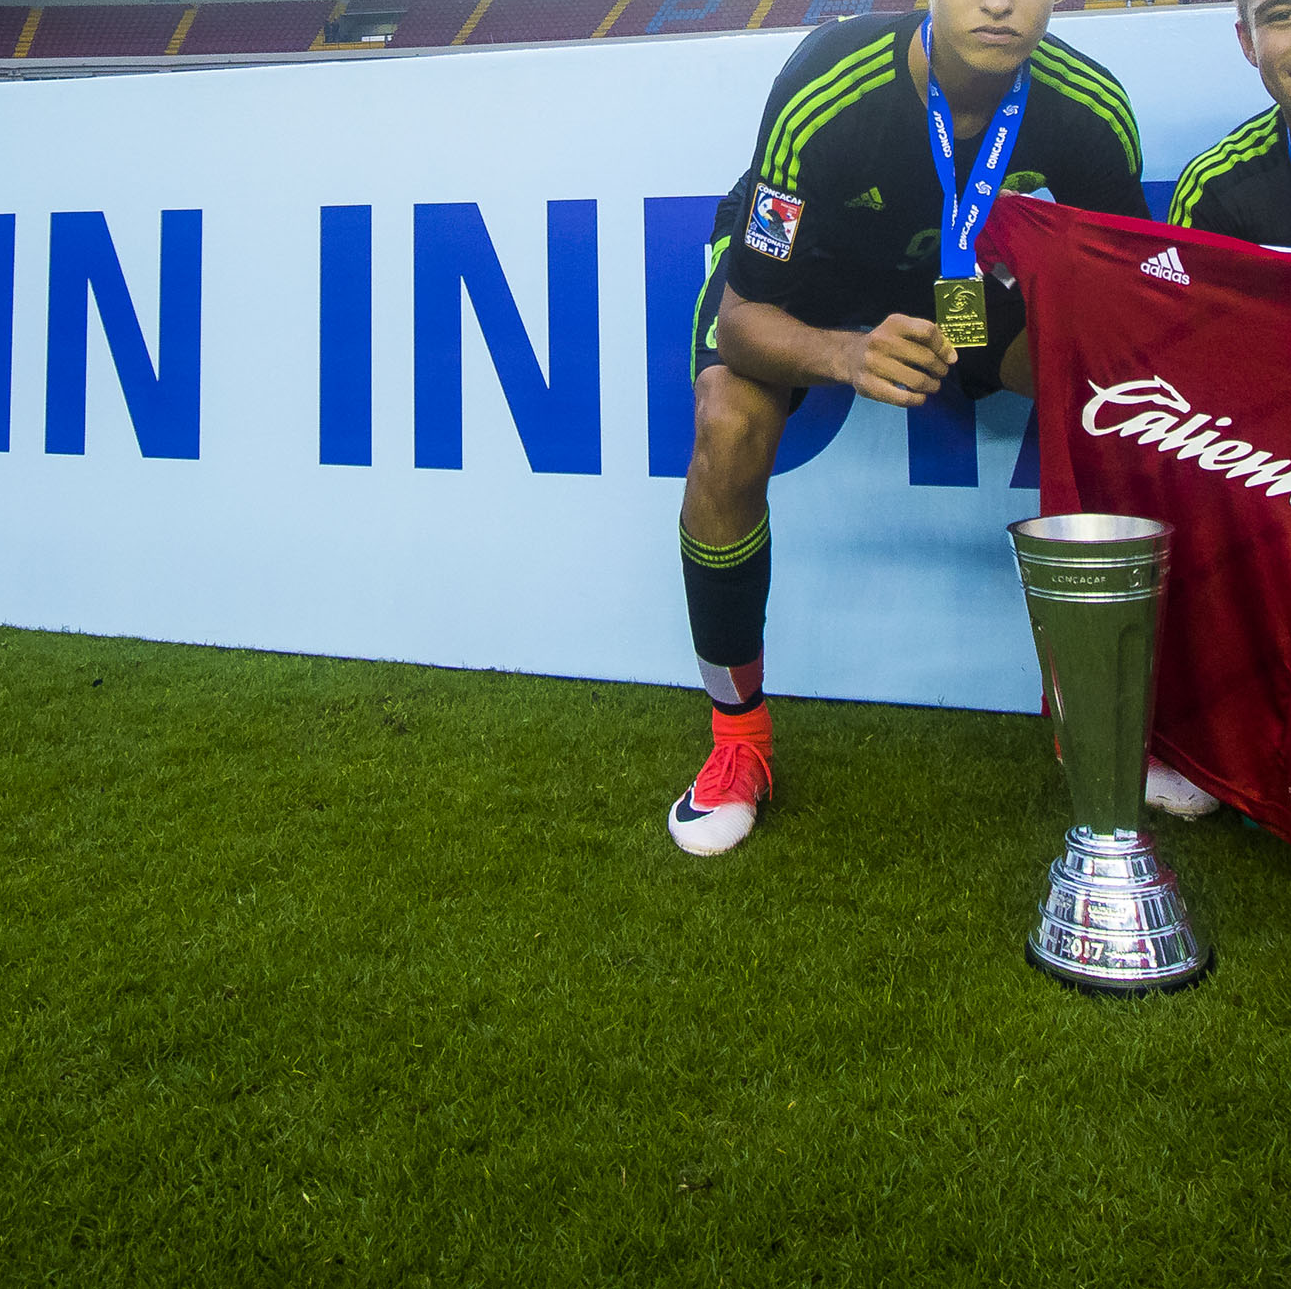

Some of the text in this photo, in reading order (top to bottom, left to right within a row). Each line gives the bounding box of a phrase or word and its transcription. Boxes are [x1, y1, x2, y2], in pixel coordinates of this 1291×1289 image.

[933, 111, 952, 158] CONCACAF
[986, 127, 1008, 170] CONCACAF
[958, 204, 980, 250] CONCACAF
[745, 235, 789, 258] SUB-17
[1140, 261, 1190, 285] adidas
[1062, 935, 1104, 961] 2017
